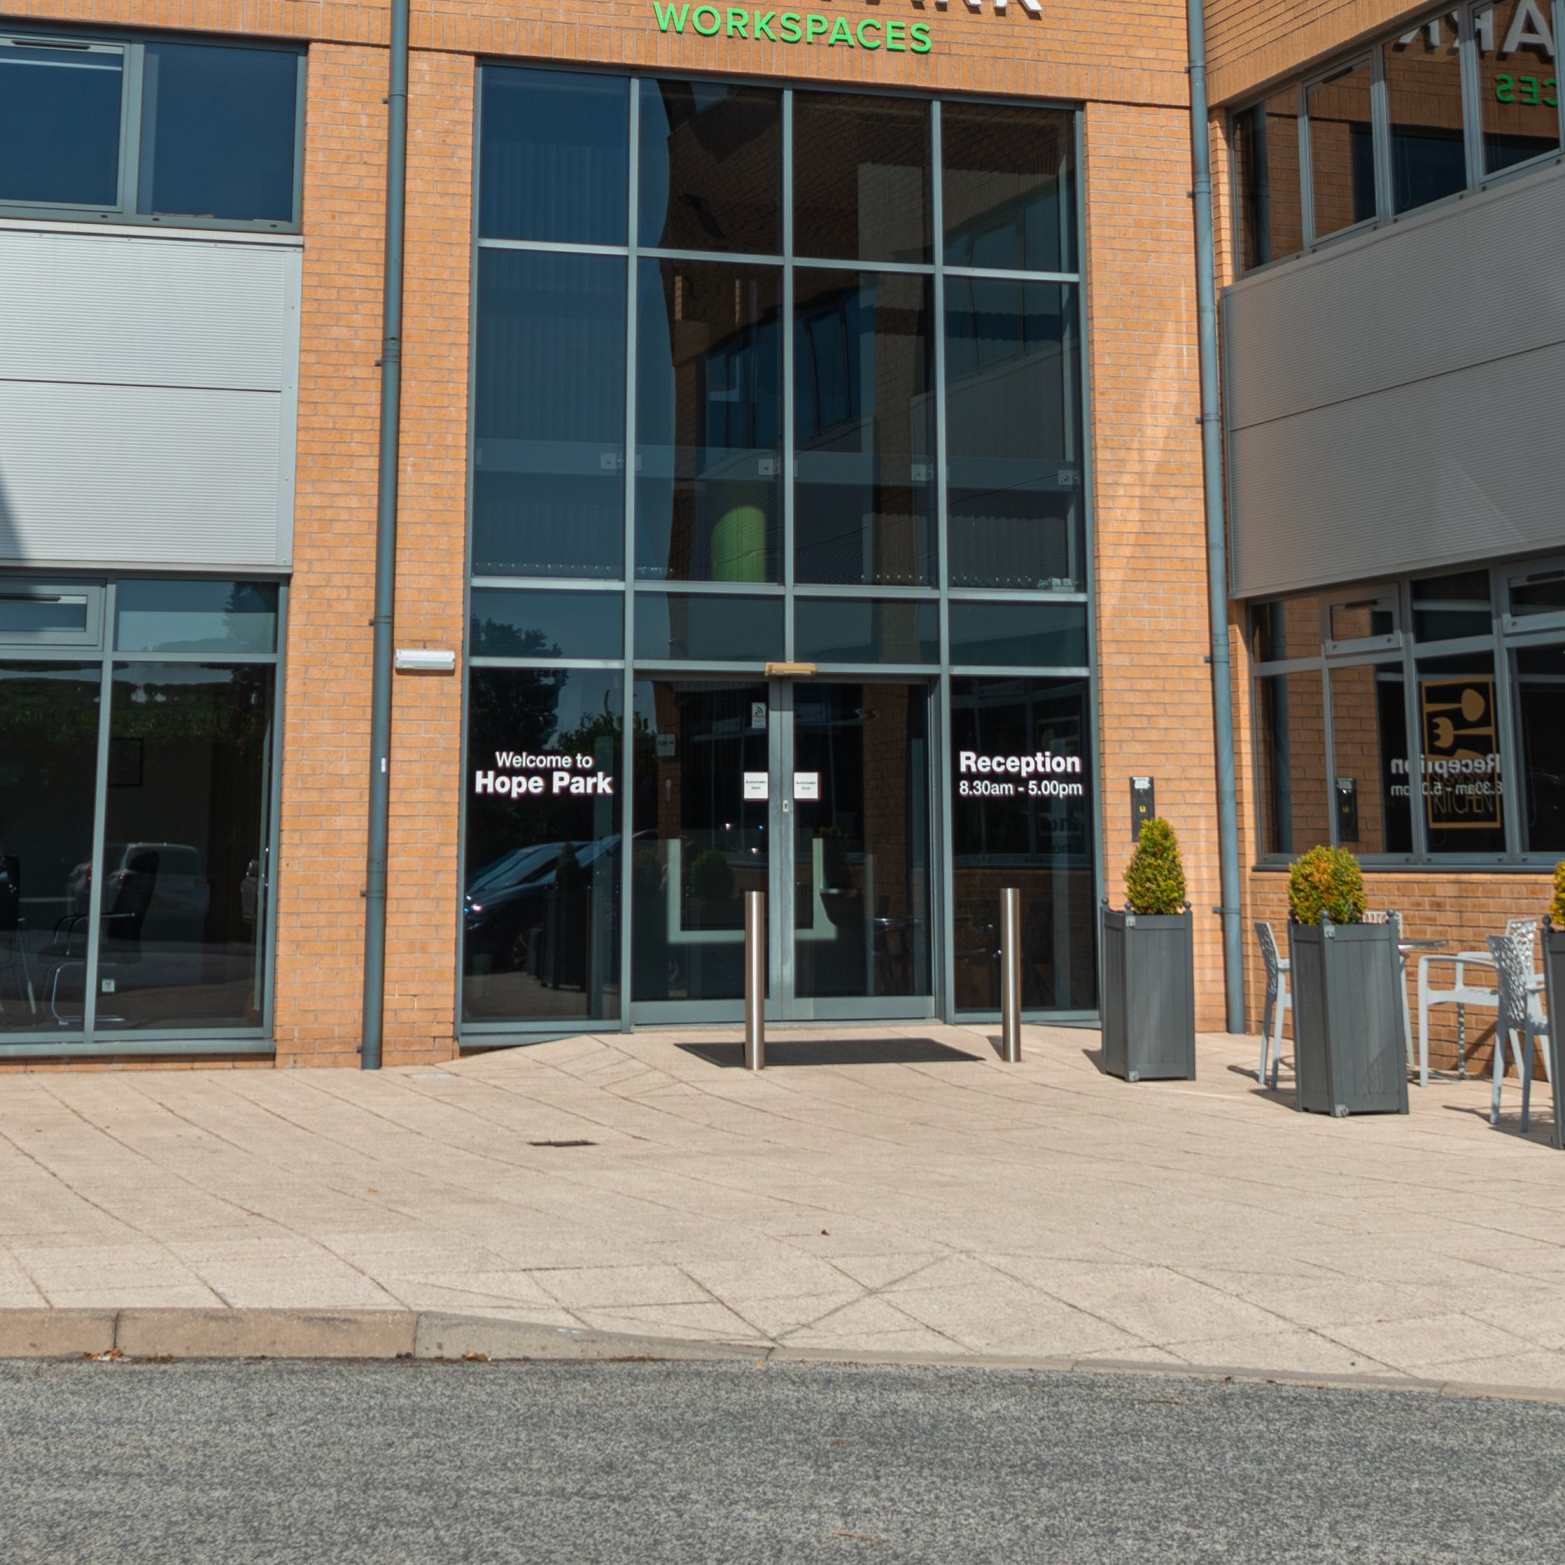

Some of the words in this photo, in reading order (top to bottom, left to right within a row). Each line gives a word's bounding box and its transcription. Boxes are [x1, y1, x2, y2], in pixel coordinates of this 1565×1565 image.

[653, 1, 932, 53] WORKSPACES
[495, 751, 572, 768] Welcome
[576, 753, 593, 768] to
[959, 751, 1081, 777] Reception
[475, 770, 544, 798] Hope
[552, 771, 613, 794] Park
[959, 780, 1014, 795] 8.30am
[1028, 780, 1083, 799] 5.00pm
